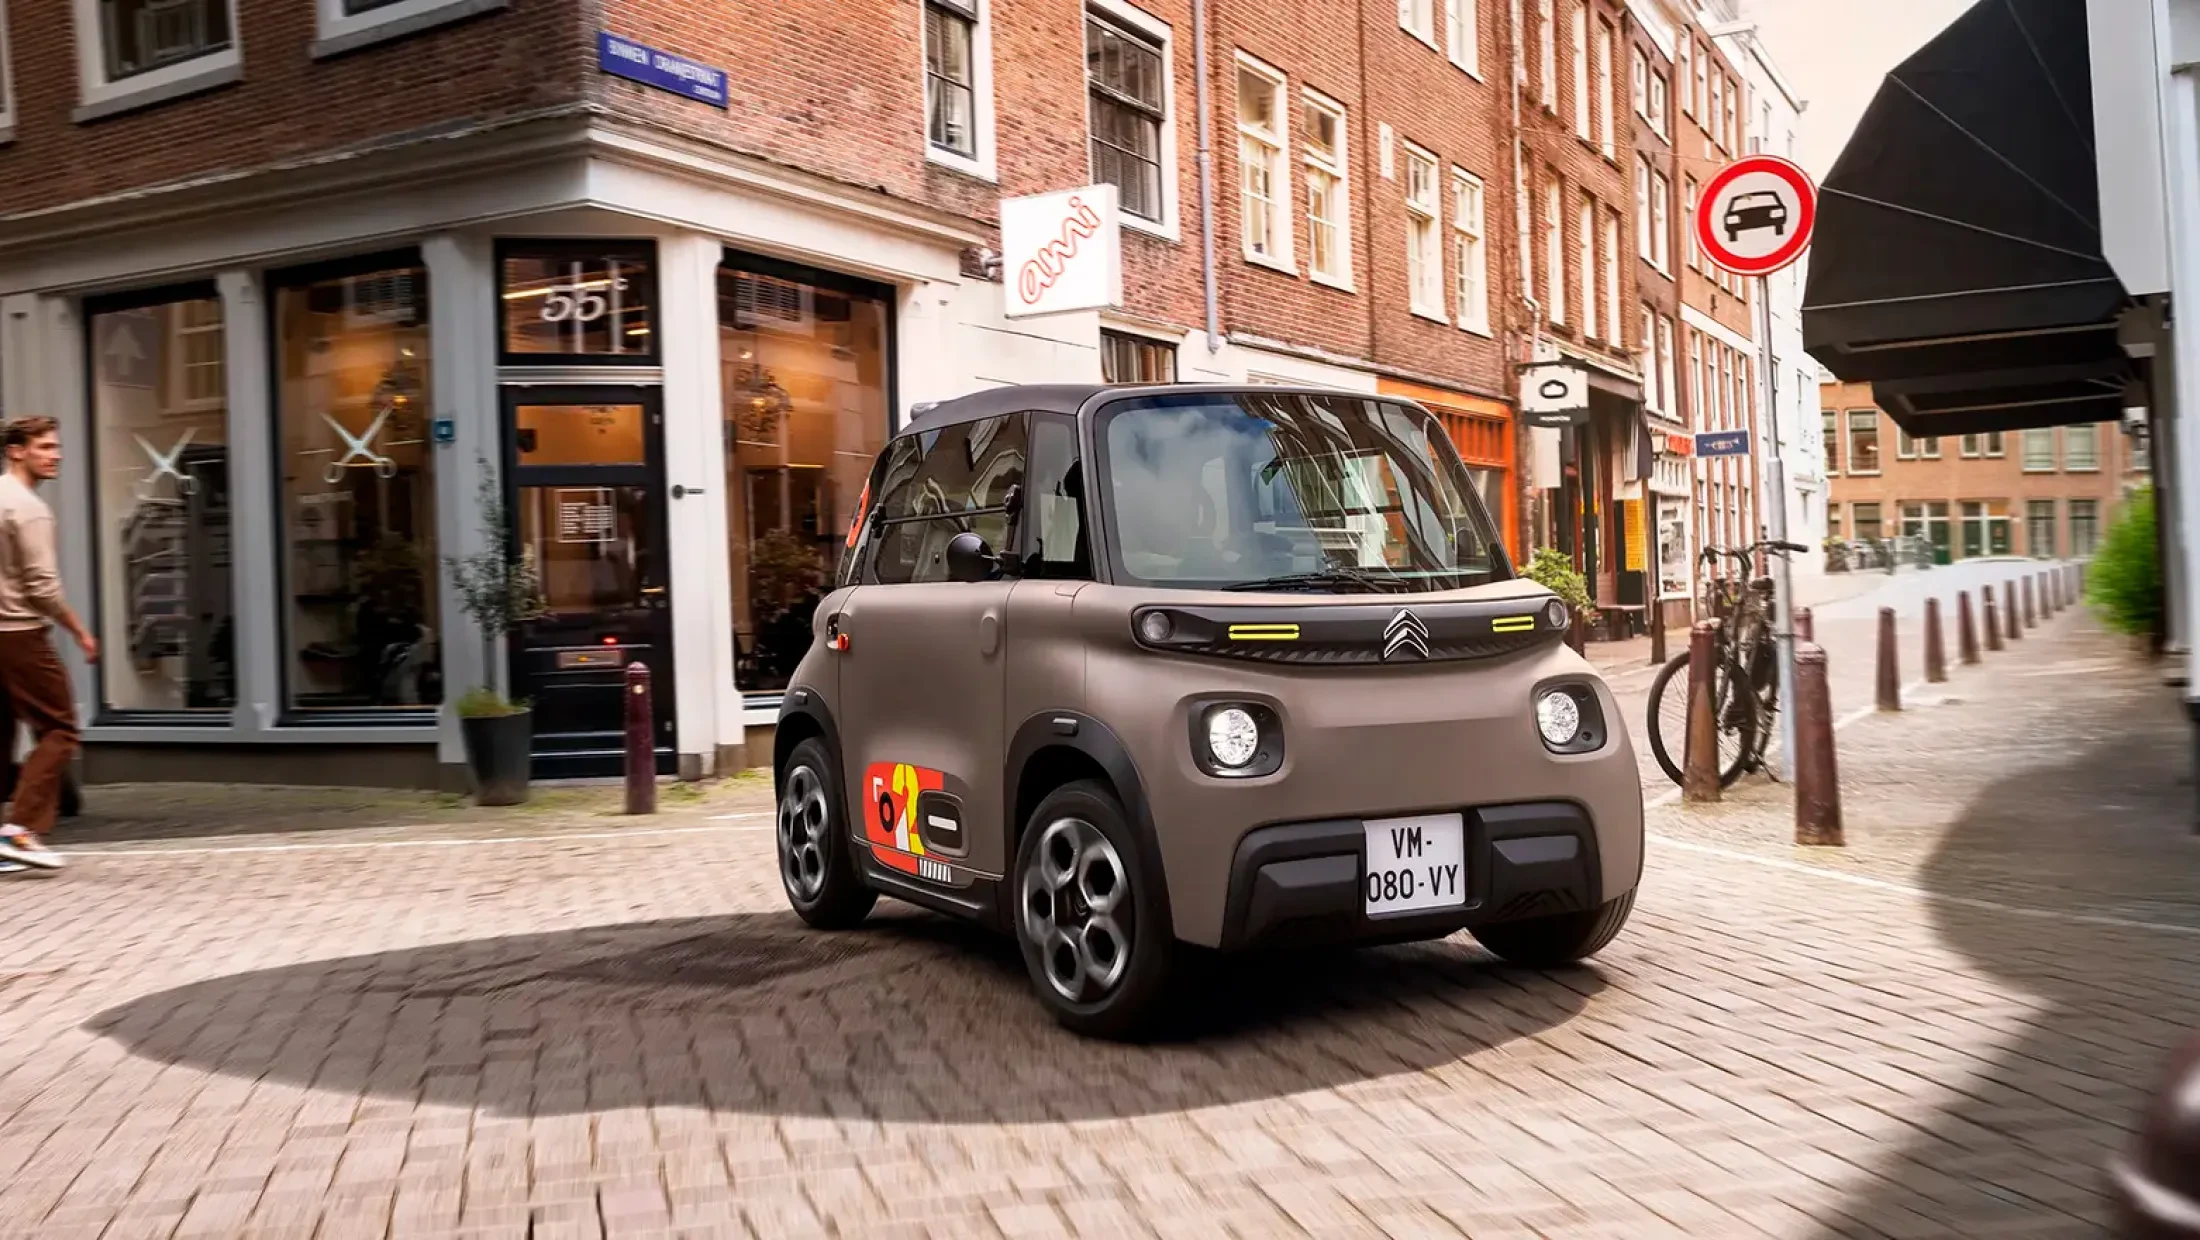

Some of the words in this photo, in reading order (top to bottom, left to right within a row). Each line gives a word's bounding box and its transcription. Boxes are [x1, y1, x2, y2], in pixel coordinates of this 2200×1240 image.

[1018, 196, 1101, 304] ami
[1391, 826, 1432, 859] VM-
[1367, 864, 1458, 902] 080-VY
